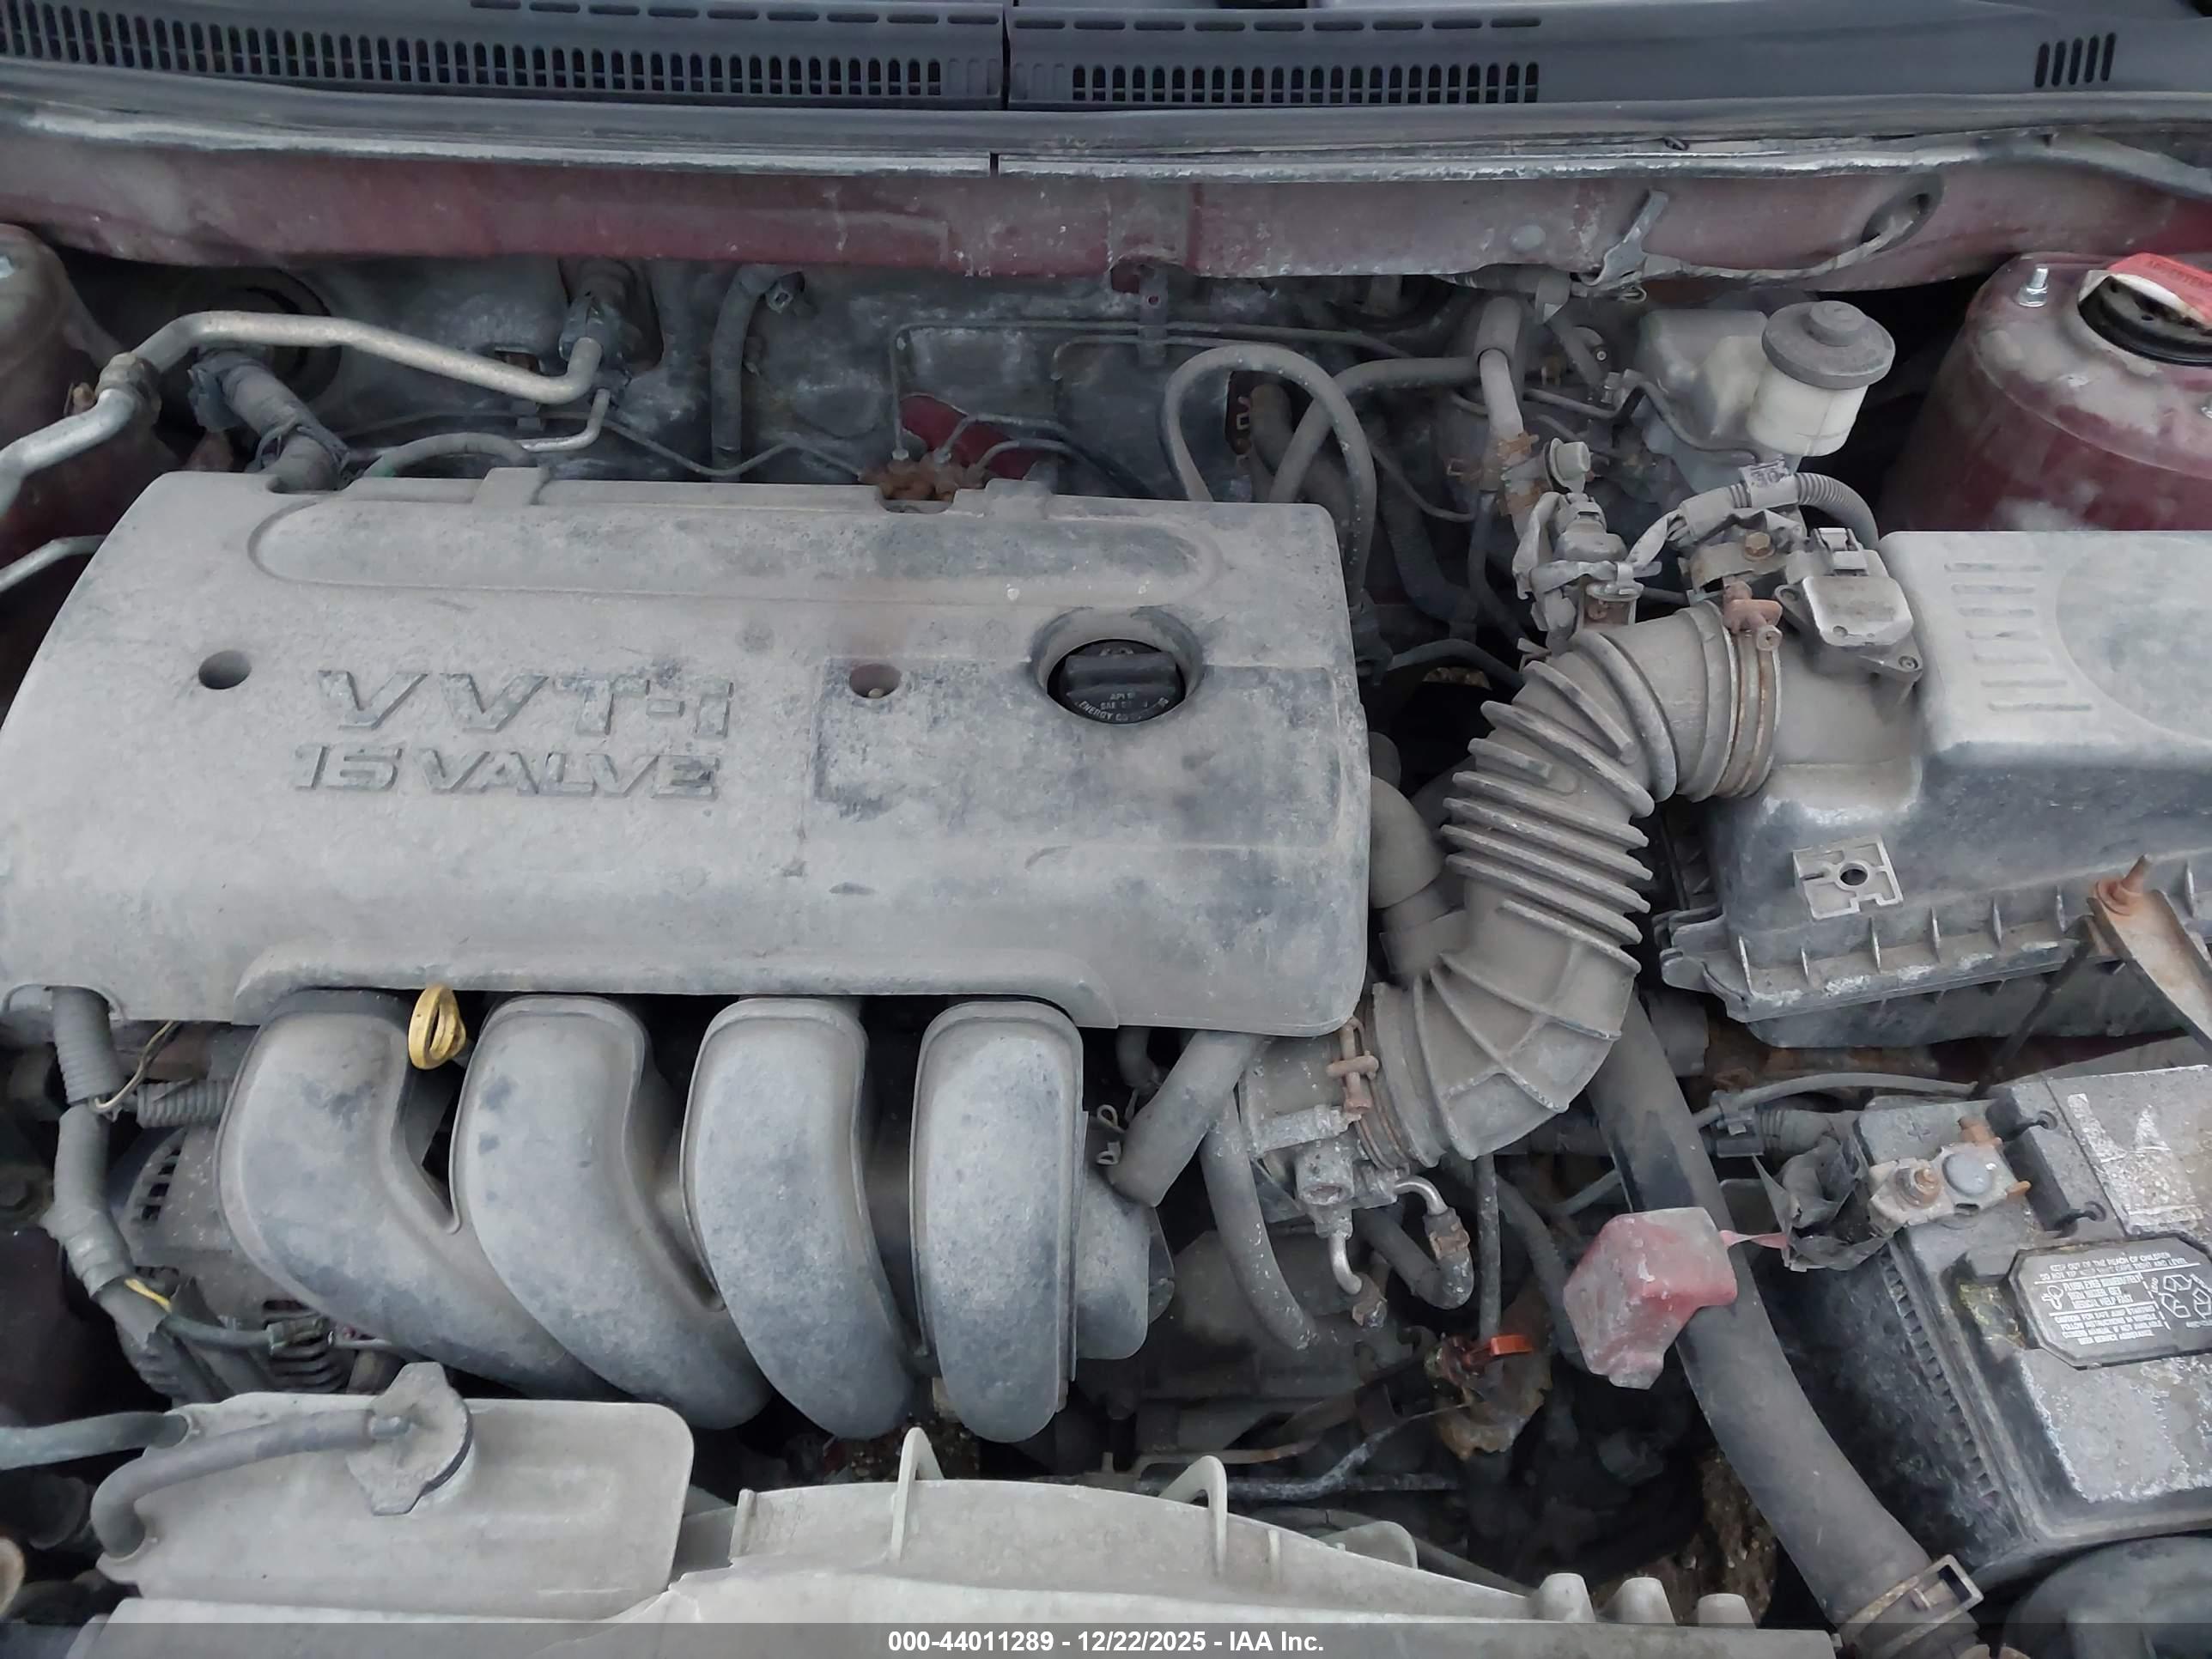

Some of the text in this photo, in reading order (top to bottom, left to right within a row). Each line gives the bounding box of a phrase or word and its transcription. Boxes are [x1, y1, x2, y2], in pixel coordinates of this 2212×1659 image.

[1079, 701, 1114, 720] ENERGY
[295, 743, 720, 799] 16 VALVE
